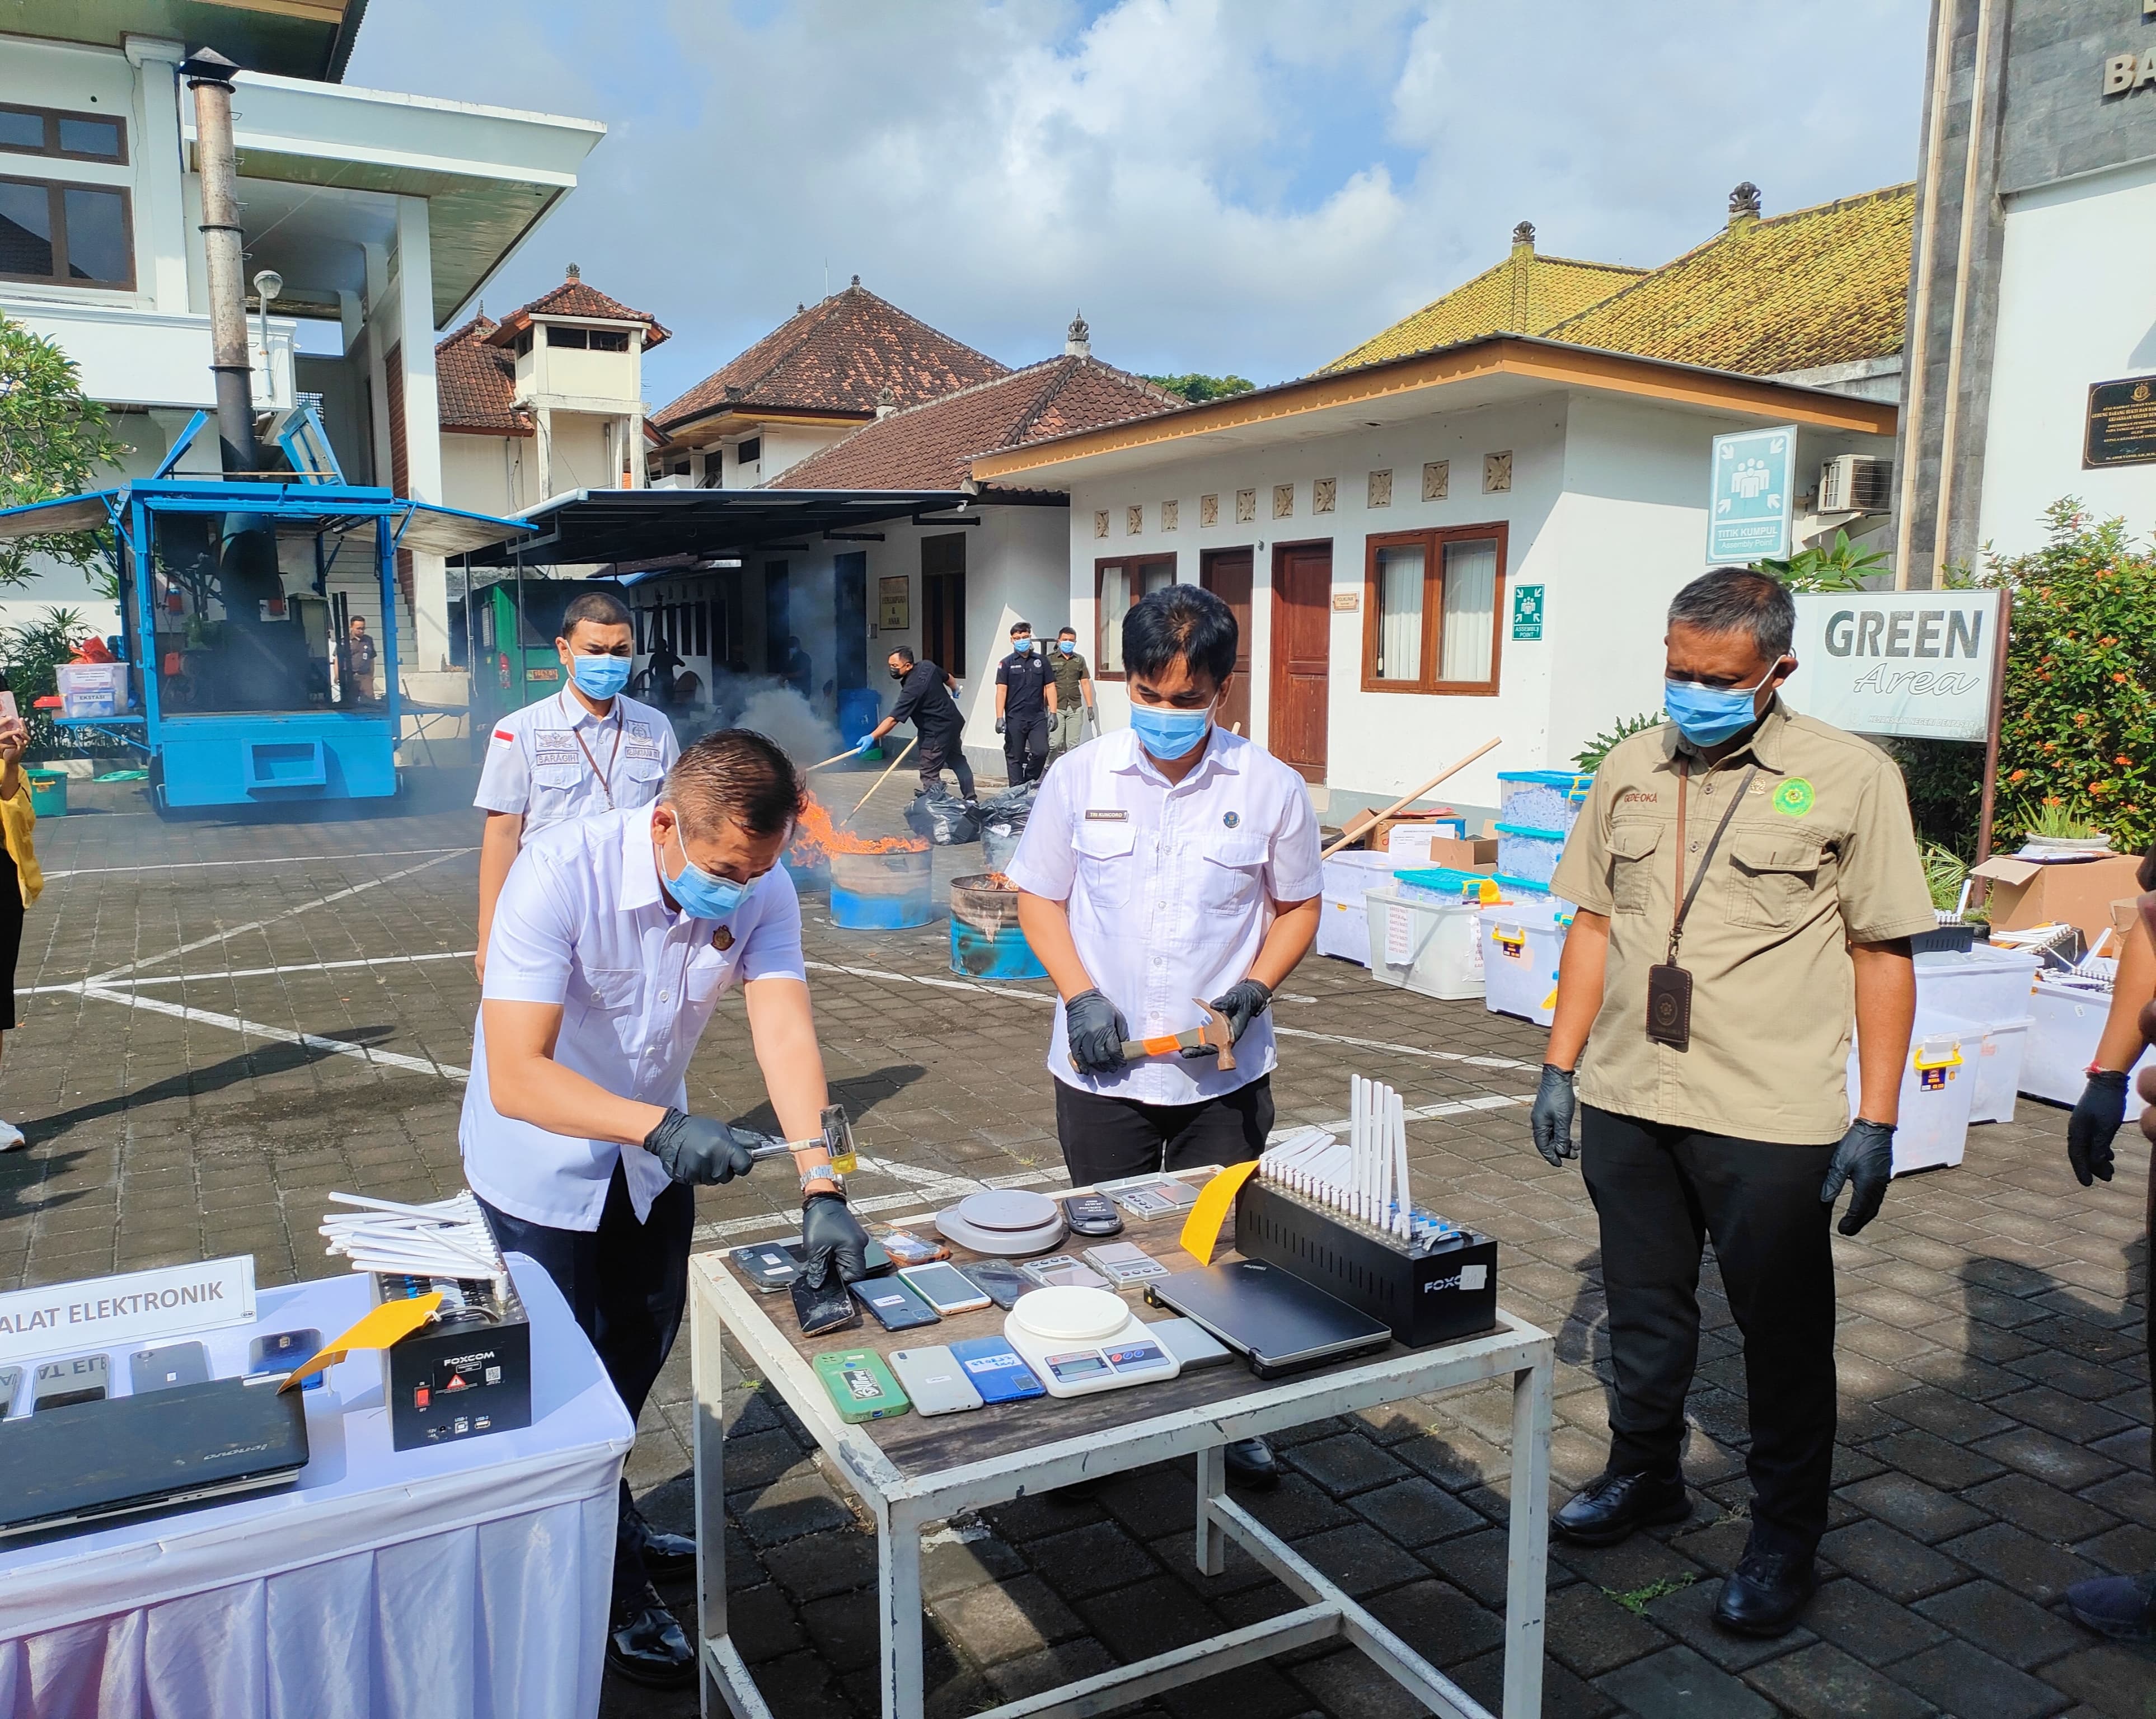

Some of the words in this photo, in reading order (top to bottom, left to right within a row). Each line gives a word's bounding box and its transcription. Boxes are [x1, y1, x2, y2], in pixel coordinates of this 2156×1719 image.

[1718, 529, 1738, 538] TITIK
[1741, 526, 1778, 537] KUMPUL
[1721, 539, 1754, 548] Assembly
[1825, 610, 1984, 659] GREEN
[1853, 663, 1980, 696] Area
[1868, 715, 1908, 725] KEJAKSAAN
[1909, 717, 1936, 726] NEGERI
[1936, 718, 1975, 728] DENPASAR
[538, 754, 576, 763] SARAGIH
[1640, 792, 1657, 802] OKA
[1424, 1275, 1461, 1293] FOXC
[0, 1307, 60, 1334] ALAT
[69, 1281, 223, 1324] ELEKTRONIK
[444, 1351, 495, 1366] FOXCOM
[204, 1444, 268, 1460] lenovo
